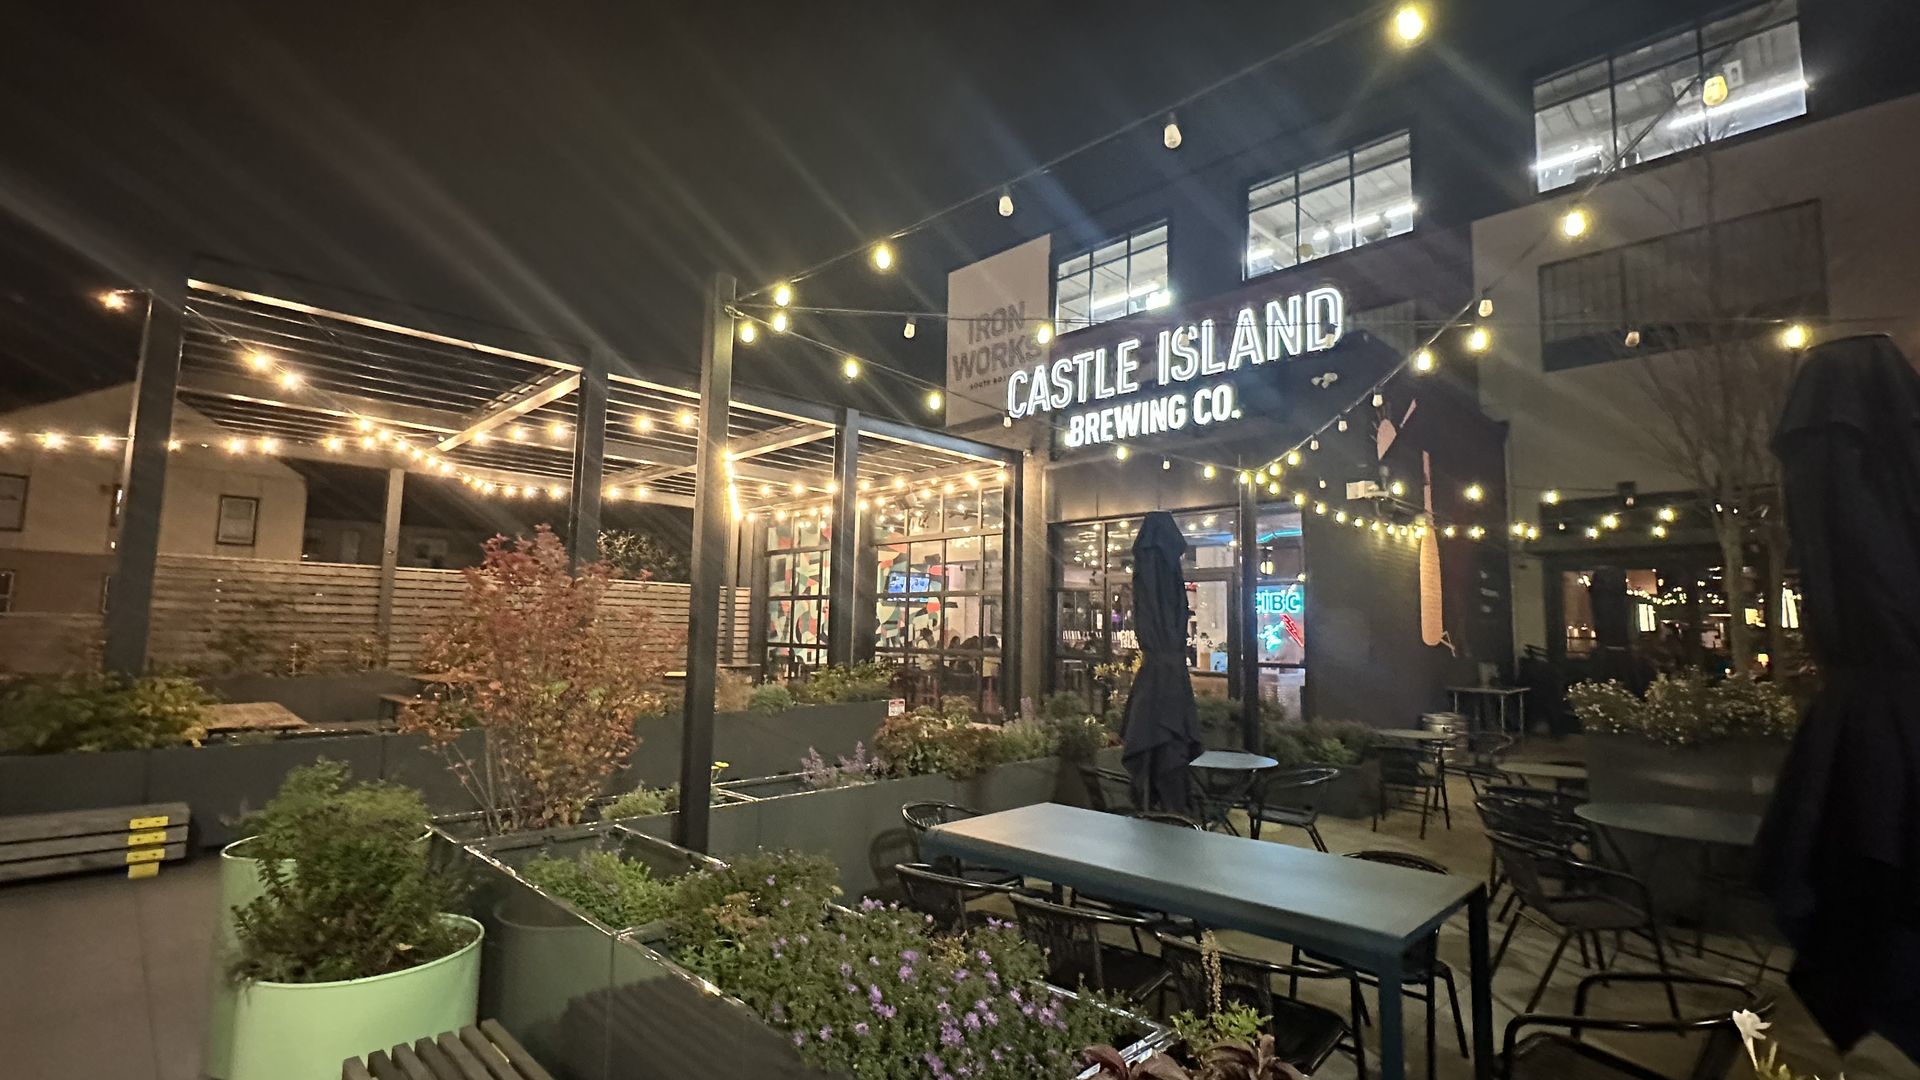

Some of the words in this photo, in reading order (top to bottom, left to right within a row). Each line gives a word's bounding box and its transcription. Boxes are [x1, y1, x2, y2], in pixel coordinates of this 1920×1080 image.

[968, 301, 1025, 345] IRON
[952, 335, 1042, 381] WORKS
[1006, 339, 1141, 419] CASTLE
[1158, 286, 1344, 386] ISLAND
[1069, 395, 1187, 448] BREWING
[1191, 383, 1242, 425] CO.
[1256, 591, 1301, 613] IBC
